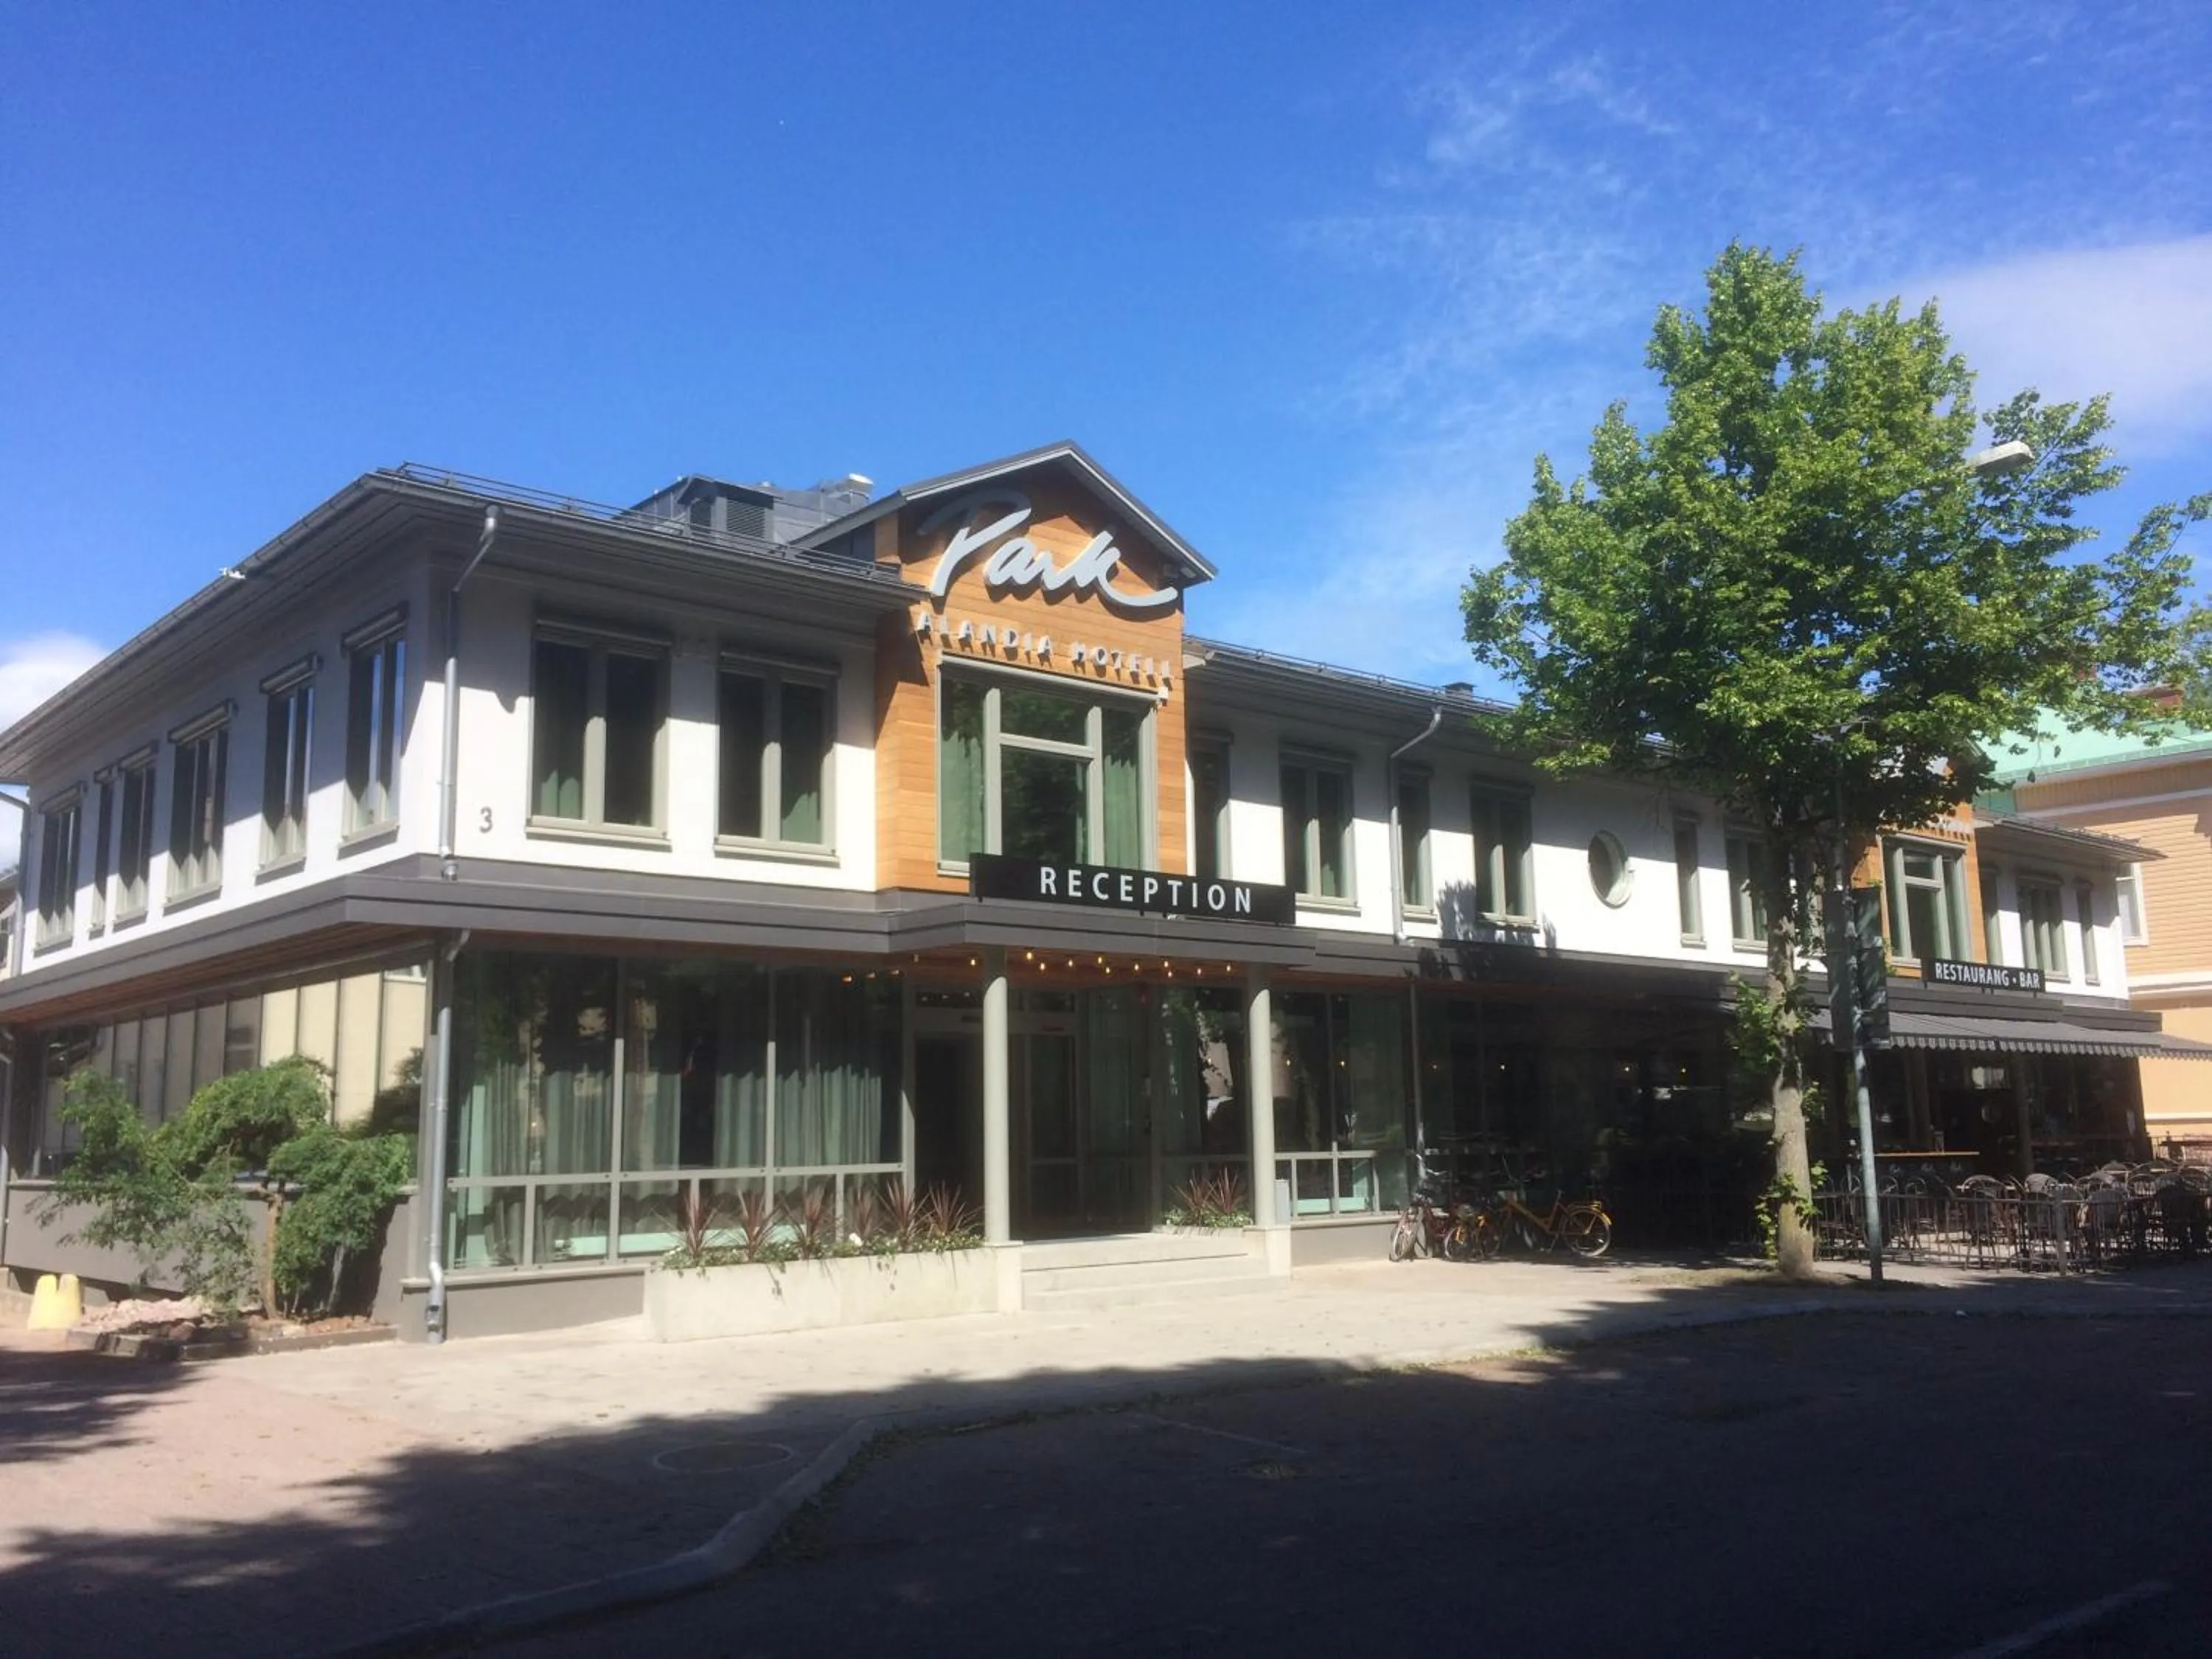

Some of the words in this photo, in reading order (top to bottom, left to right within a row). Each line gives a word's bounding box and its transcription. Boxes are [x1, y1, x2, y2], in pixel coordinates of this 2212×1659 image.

[917, 488, 1178, 608] Park
[917, 611, 1052, 658] ALANDIA
[1072, 640, 1171, 680] HOTELL
[479, 806, 493, 834] 3
[1040, 866, 1251, 914] RECEPTION
[1935, 962, 2009, 987] RESTAURANG
[2019, 971, 2040, 989] BAR
